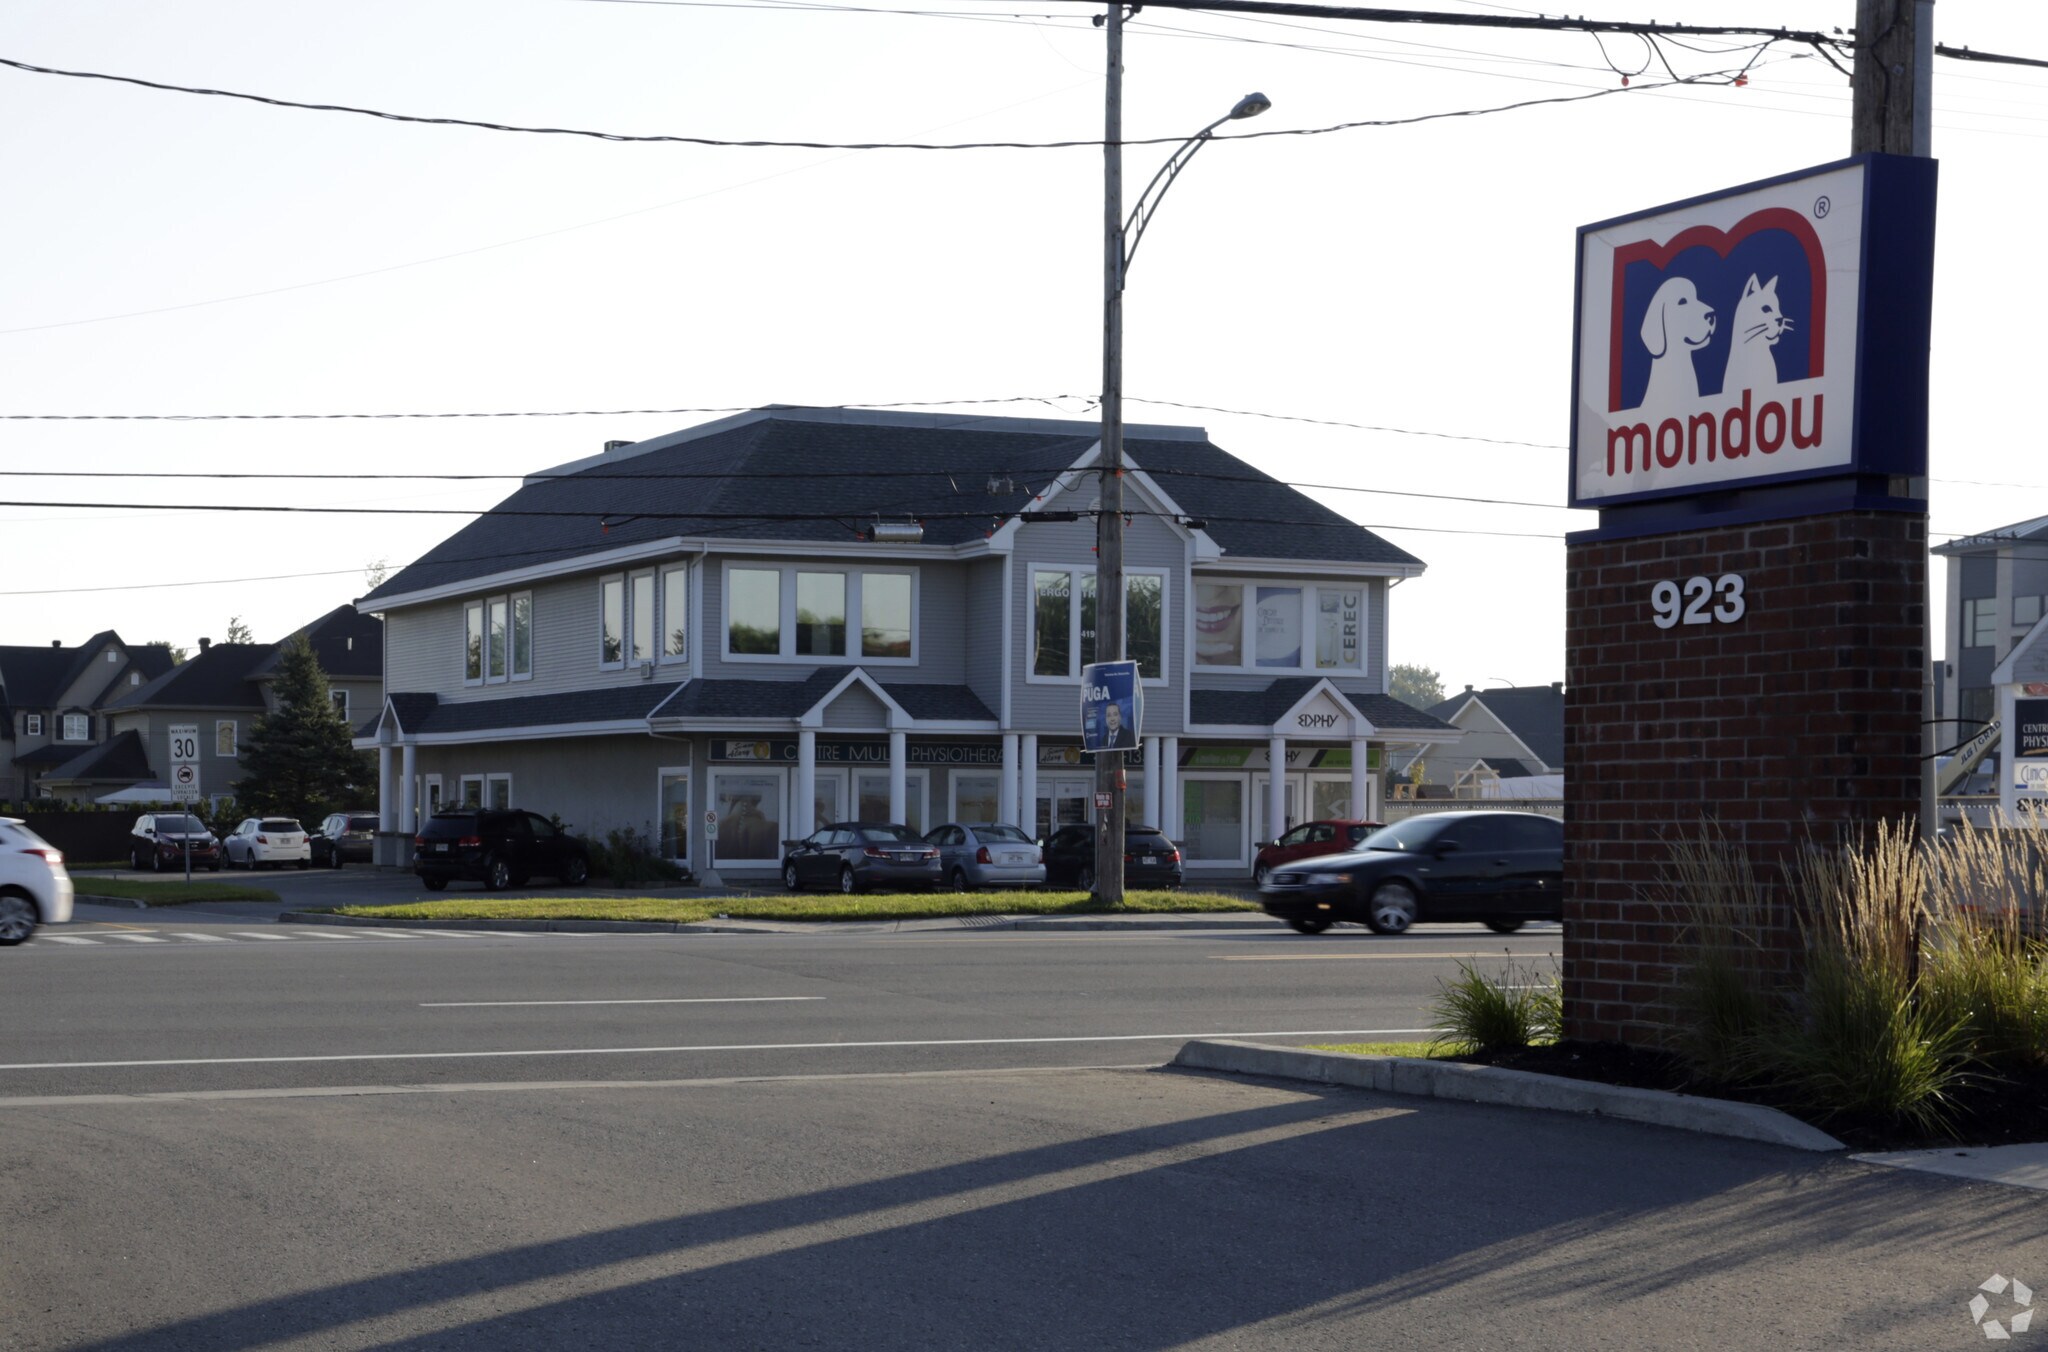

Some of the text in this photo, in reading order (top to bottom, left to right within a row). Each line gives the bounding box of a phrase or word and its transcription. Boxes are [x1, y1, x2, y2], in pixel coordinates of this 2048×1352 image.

[1606, 388, 1825, 477] mondou
[1650, 573, 1746, 630] 923
[1343, 595, 1357, 663] CEREC
[1083, 685, 1111, 702] PUGA
[174, 738, 195, 758] 30
[784, 744, 841, 761] CTRE
[1961, 720, 2001, 765] JLG GRAD
[2023, 735, 2048, 747] PHYSI
